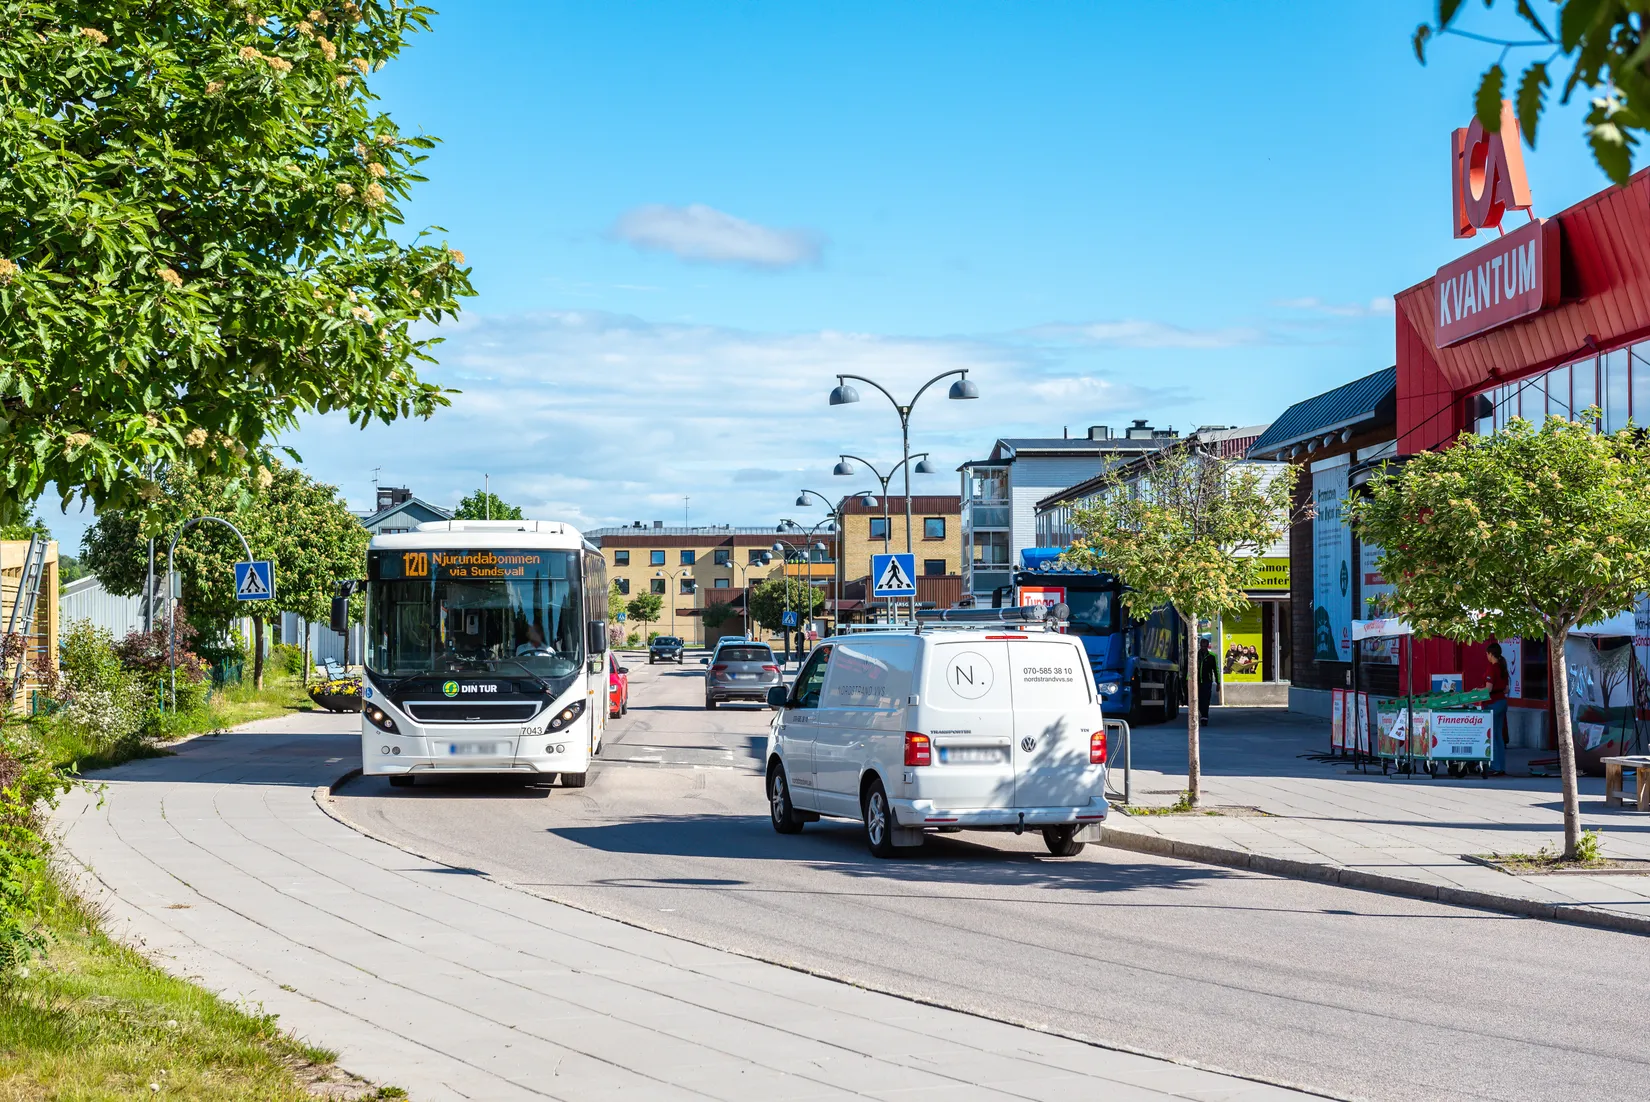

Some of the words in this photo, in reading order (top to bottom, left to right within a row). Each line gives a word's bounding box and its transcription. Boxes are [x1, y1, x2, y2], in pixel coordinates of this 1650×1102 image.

[1451, 99, 1533, 239] ICA
[1440, 239, 1536, 328] KVANTUM
[403, 552, 428, 577] 120
[432, 552, 541, 567] Njurundabommen
[450, 567, 467, 577] via
[471, 566, 525, 577] Sundsvall
[1023, 667, 1052, 675] 070-585
[1053, 667, 1063, 675] 38
[1065, 667, 1073, 675] 10
[461, 684, 478, 694] DIN
[479, 684, 498, 693] TUR
[1437, 715, 1484, 726] Finnerödja
[521, 726, 543, 735] 7043
